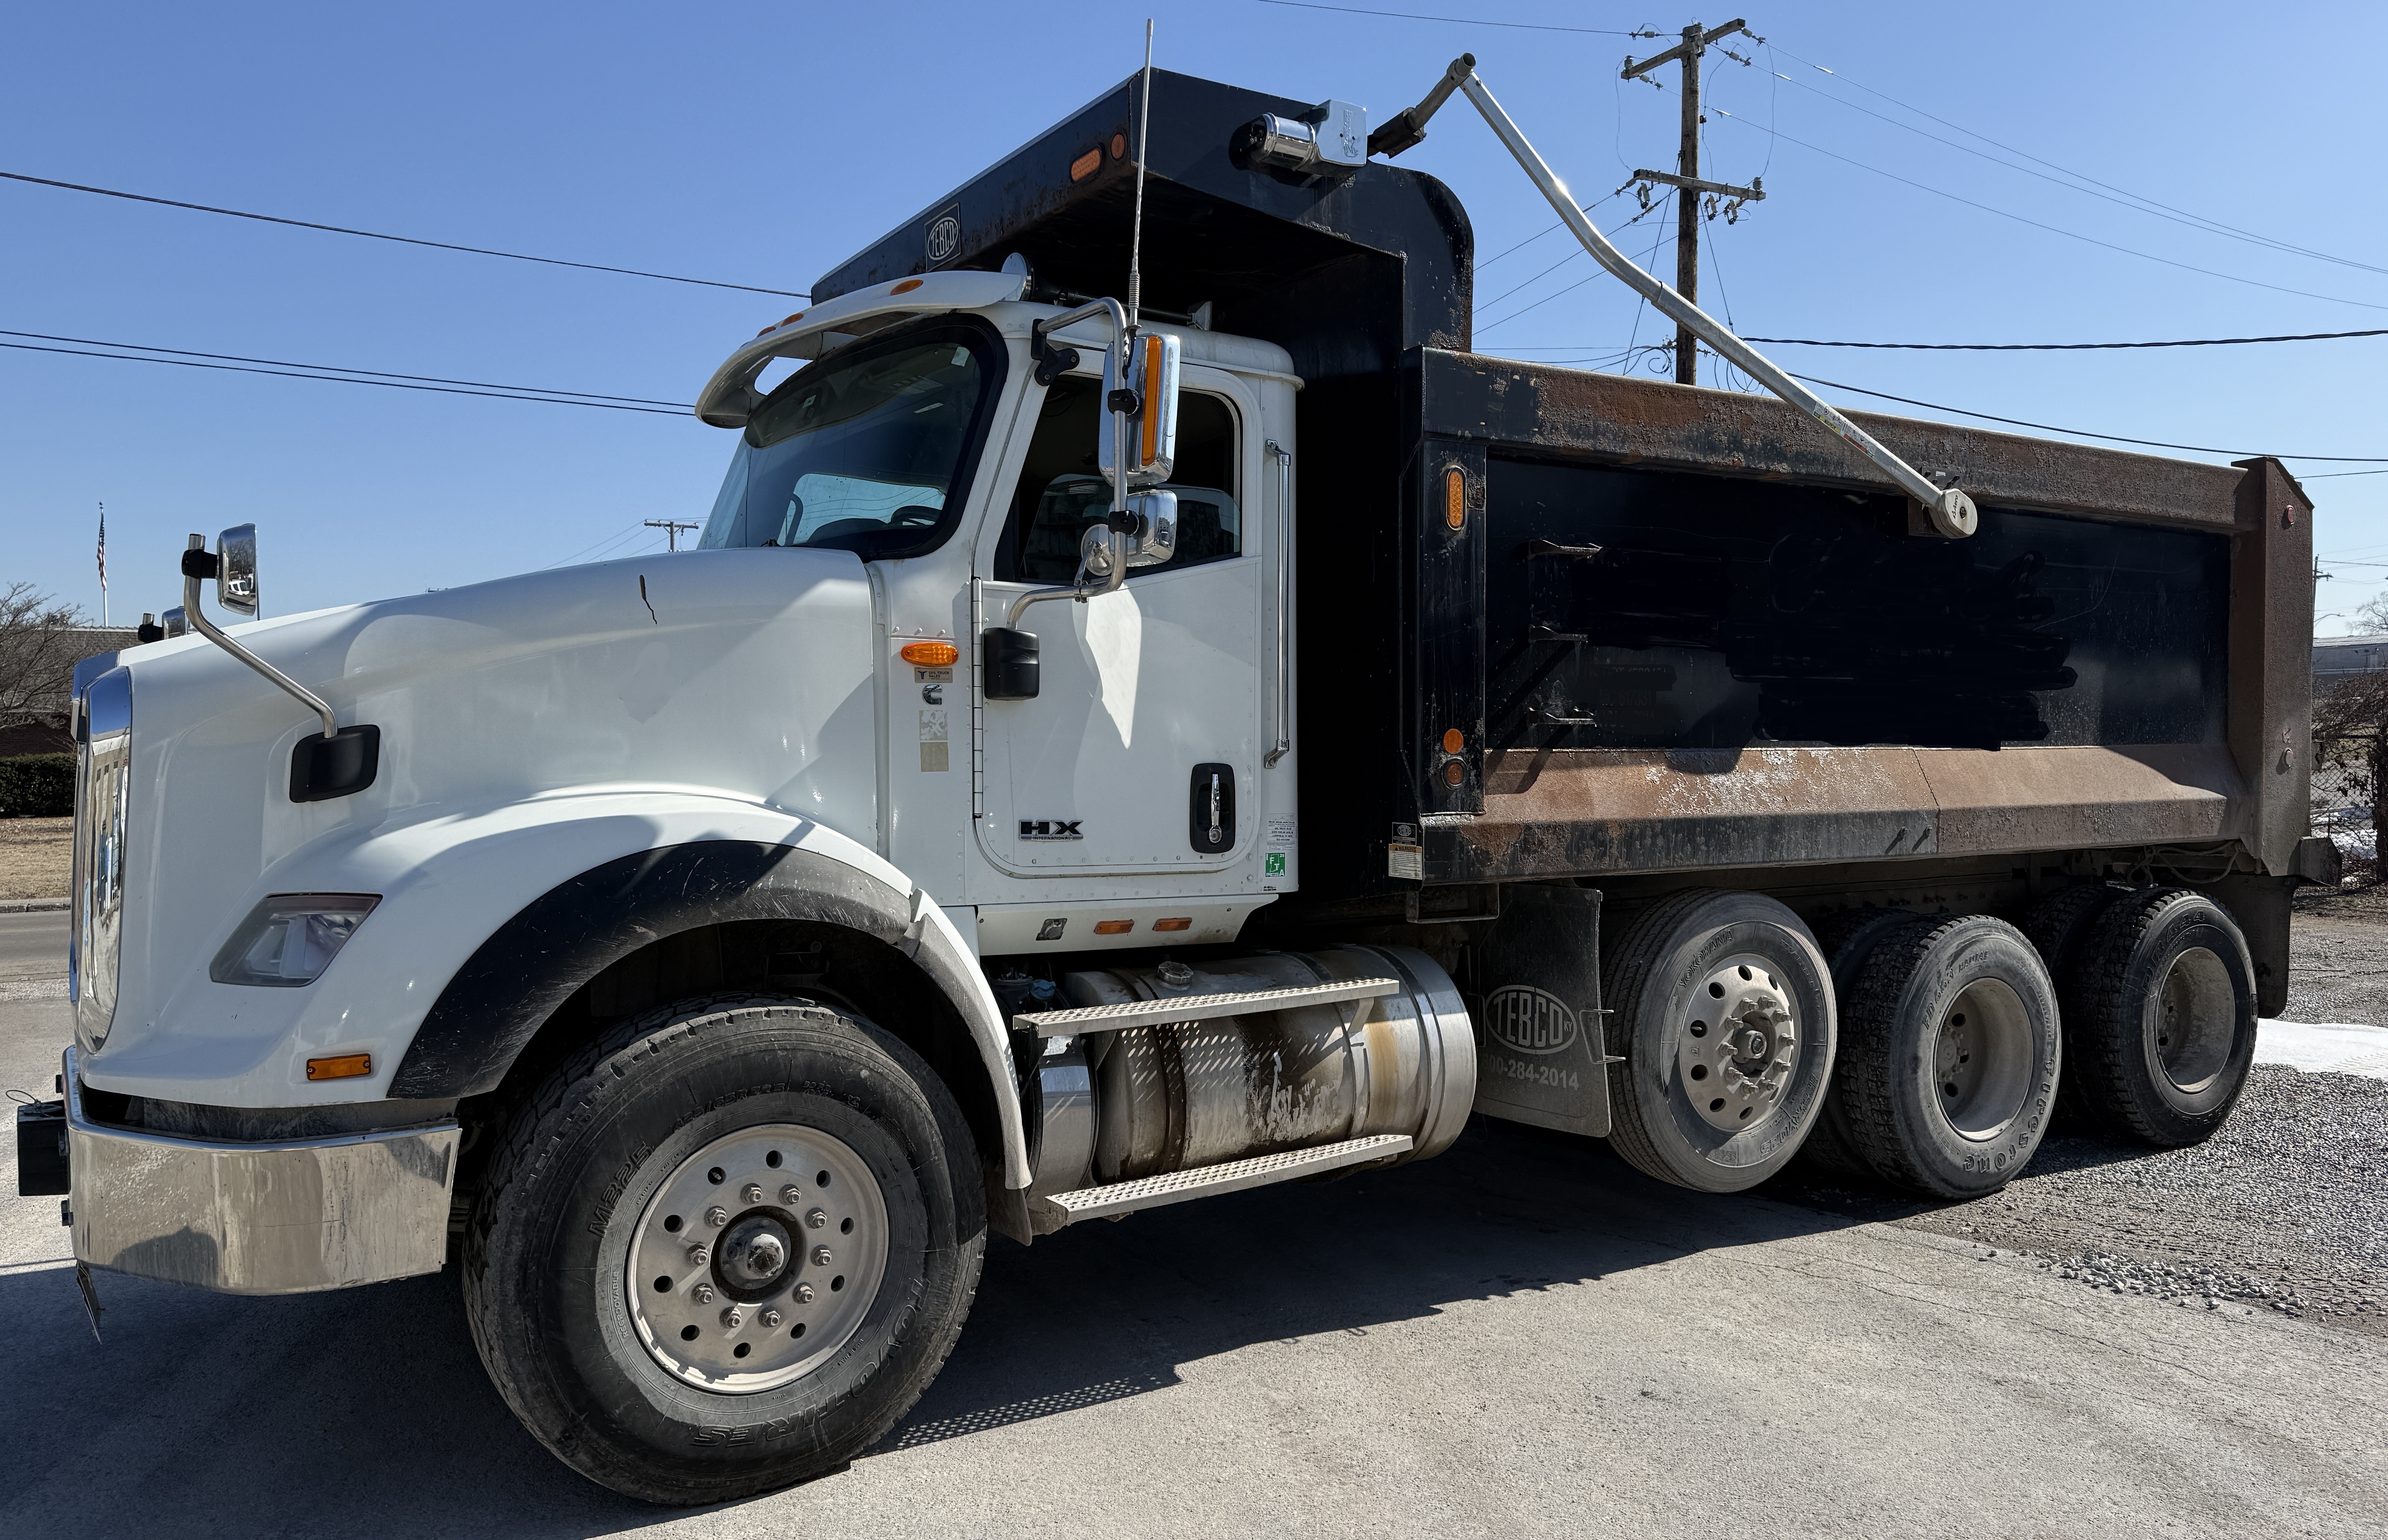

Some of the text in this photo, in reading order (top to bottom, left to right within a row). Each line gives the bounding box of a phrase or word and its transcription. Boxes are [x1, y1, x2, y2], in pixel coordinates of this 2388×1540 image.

[931, 221, 955, 257] TEBCO
[1019, 820, 1083, 836] HX
[1678, 929, 1734, 988] YOKOHAMA
[1493, 992, 1572, 1047] TEBCO KY
[1963, 1057, 2056, 1173] Firestone
[587, 1140, 654, 1238] M325
[688, 1278, 931, 1448] TOYO TIRES
